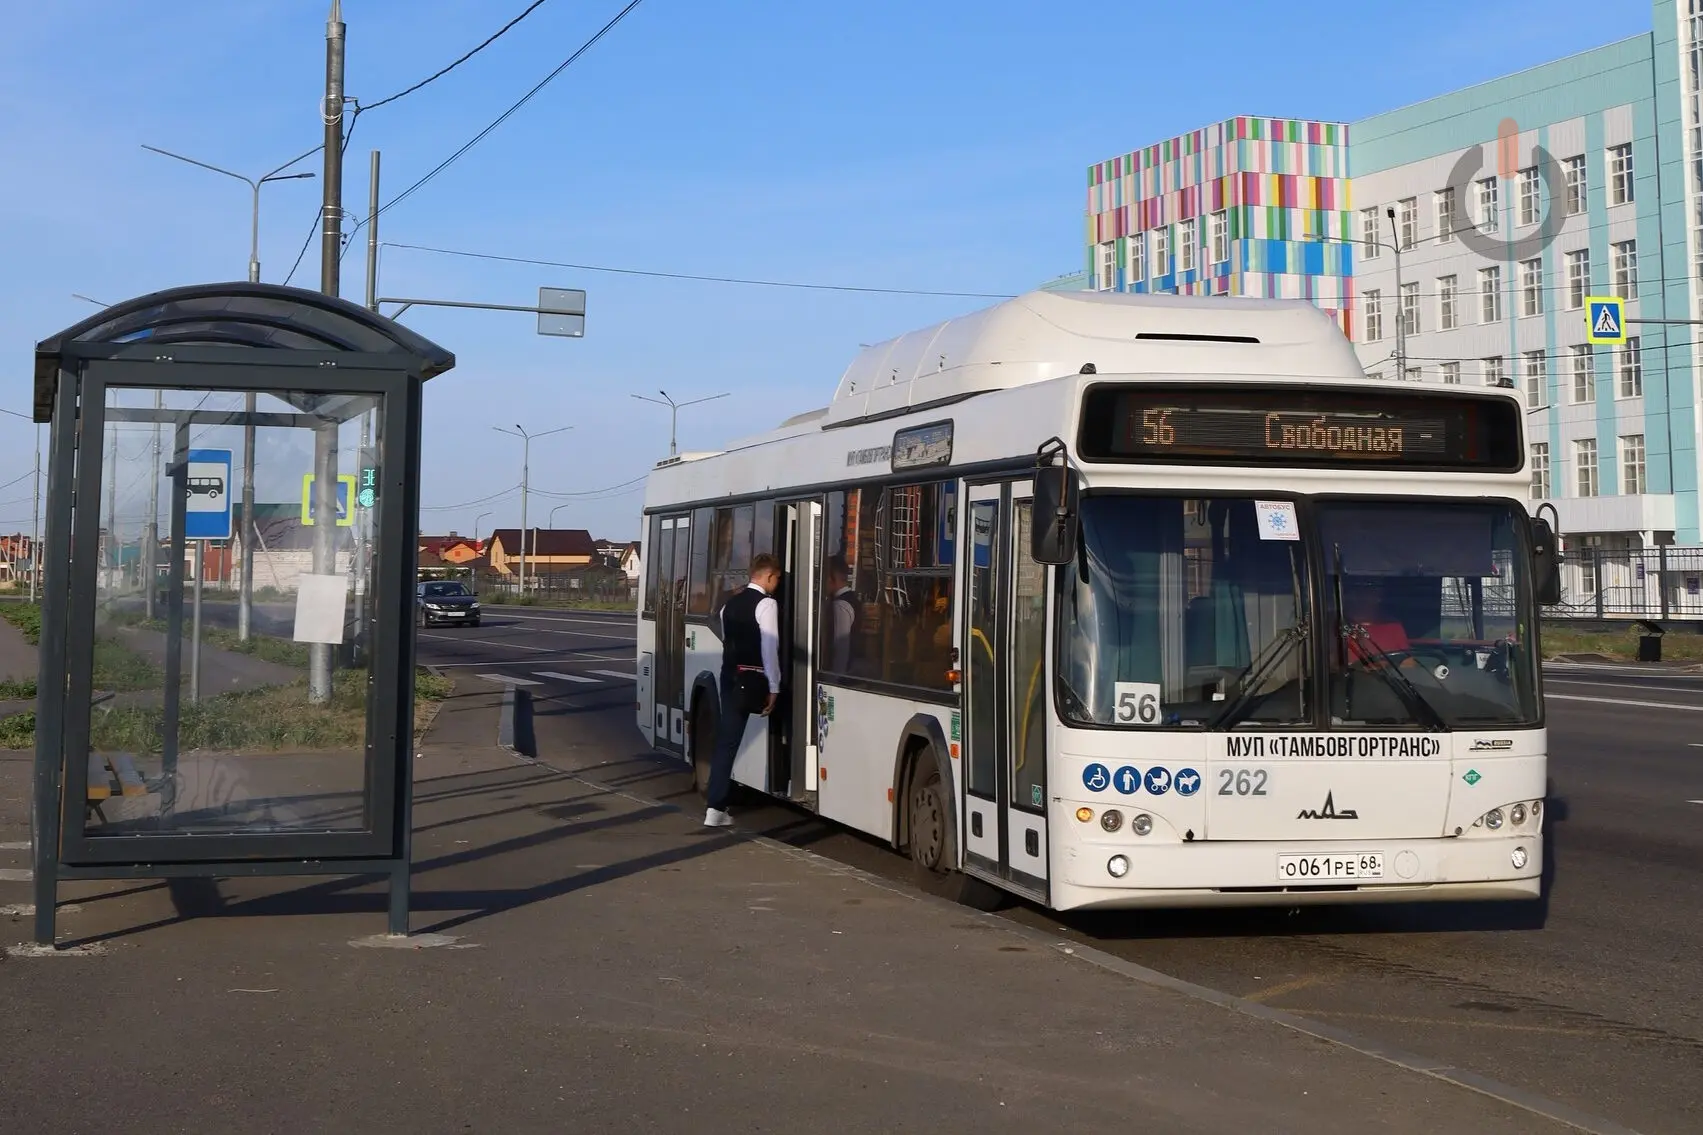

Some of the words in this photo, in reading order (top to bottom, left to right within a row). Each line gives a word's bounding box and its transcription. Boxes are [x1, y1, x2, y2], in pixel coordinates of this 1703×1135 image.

[1143, 409, 1174, 444] 56
[1265, 413, 1402, 451] Свободная
[1260, 503, 1291, 511] АВТОБУС
[1117, 692, 1156, 723] 56
[1226, 736, 1264, 757] МУП
[1269, 736, 1440, 757] «ТАМБОВГОРТРАНС»
[1218, 768, 1268, 796] 262
